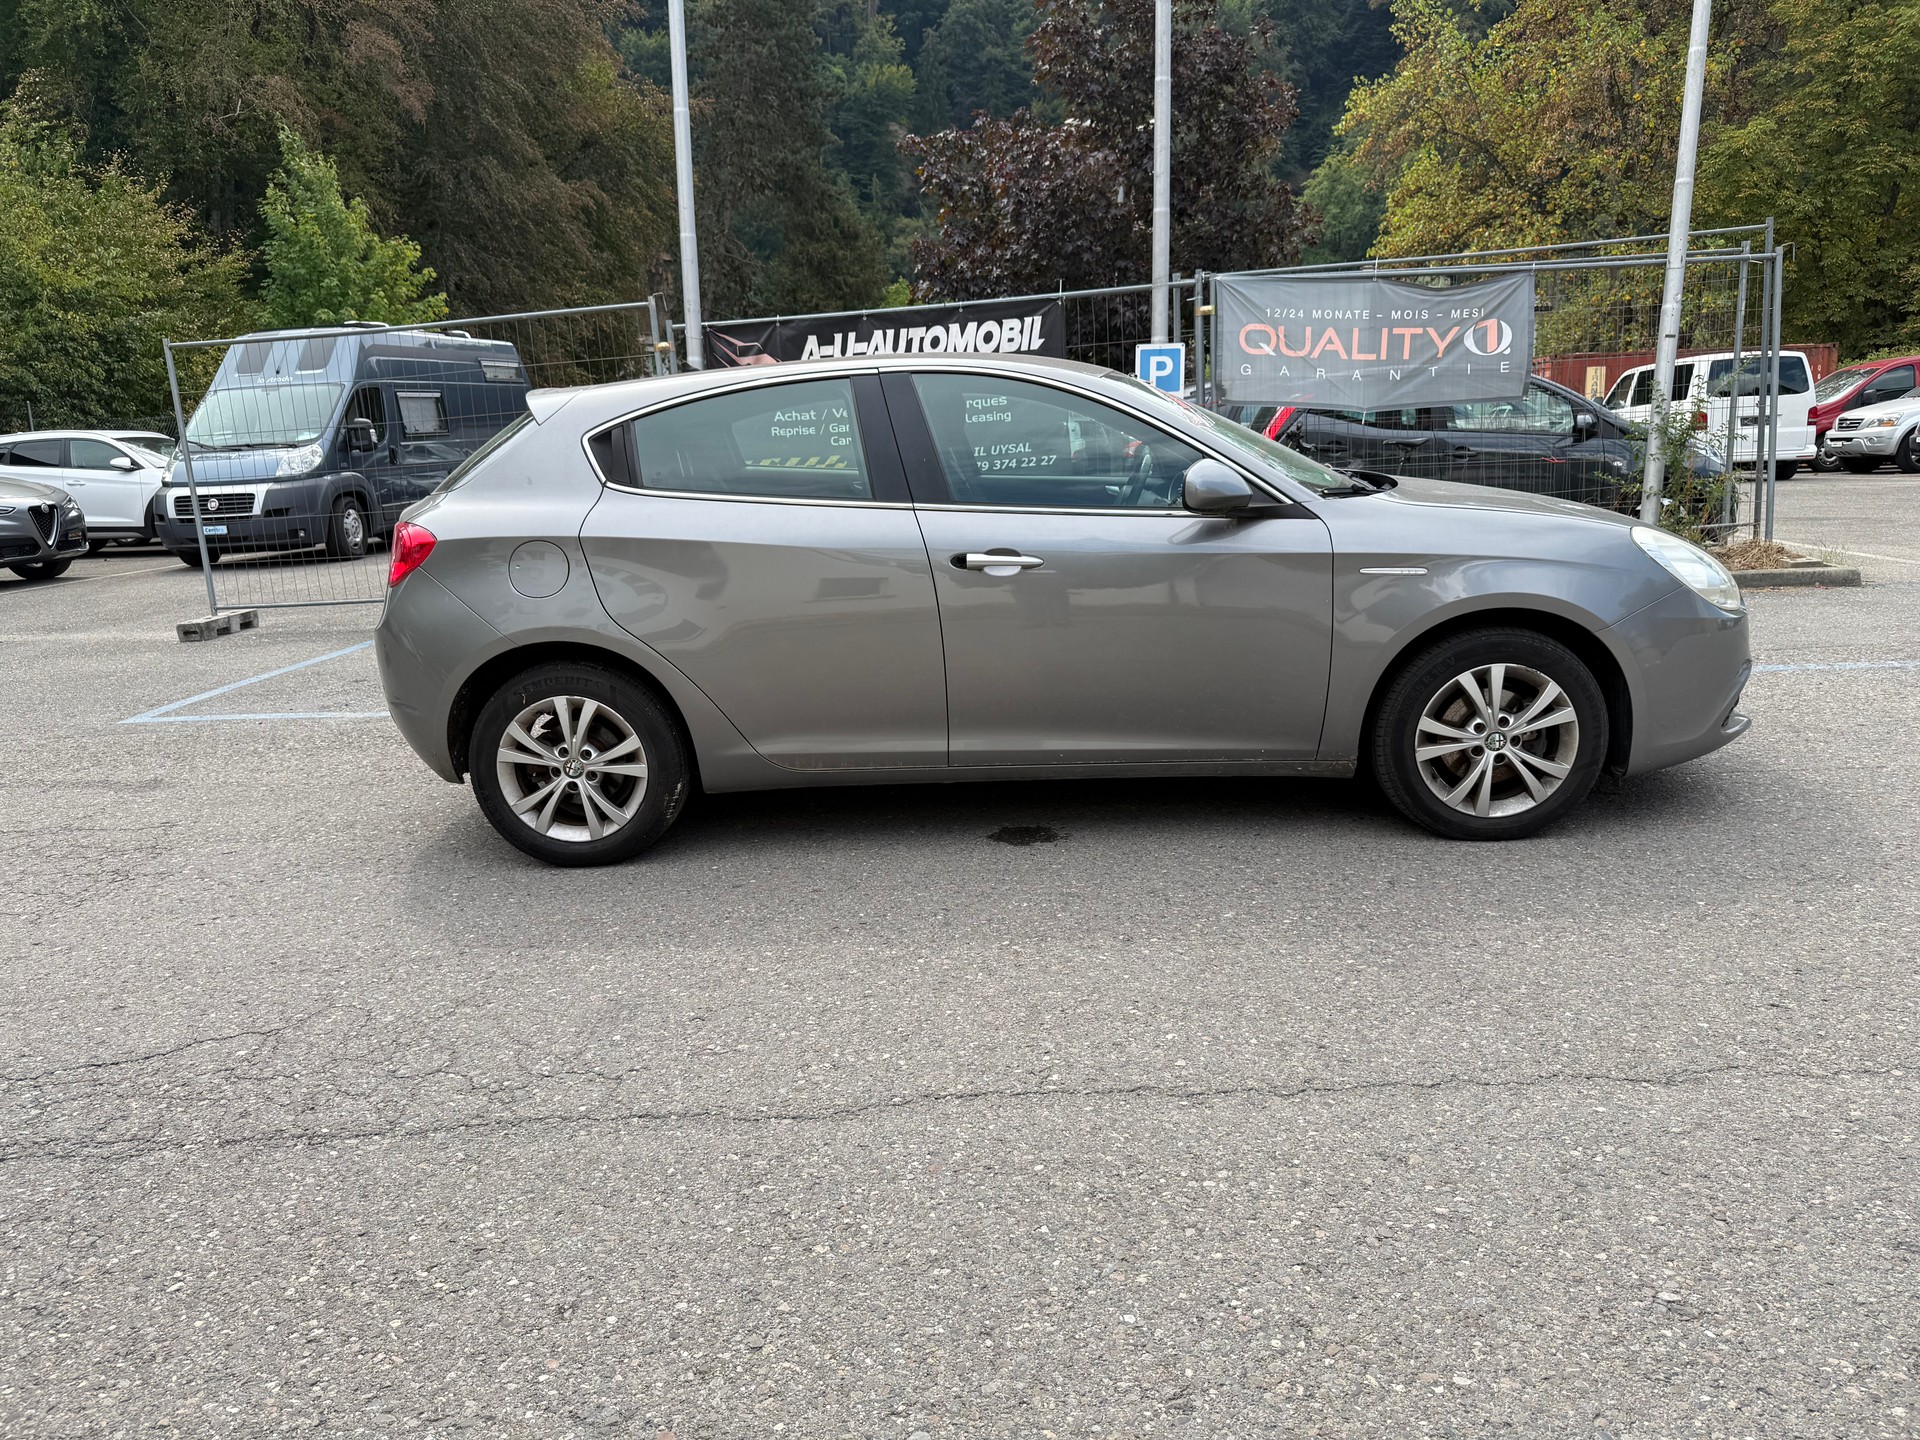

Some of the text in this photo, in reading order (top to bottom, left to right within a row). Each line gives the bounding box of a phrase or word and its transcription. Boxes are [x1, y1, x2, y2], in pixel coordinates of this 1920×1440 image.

[1265, 308, 1305, 319] 12/24
[1312, 309, 1370, 320] MONATE
[1391, 309, 1430, 320] MOIS
[1451, 308, 1485, 319] MESI
[1238, 323, 1461, 360] QUALITY
[1149, 355, 1174, 388] P
[1240, 361, 1510, 381] GARANTIE
[774, 409, 817, 422] Achat
[966, 396, 1008, 410] rques
[771, 425, 816, 438] Reprise
[965, 411, 1012, 424] Leasing
[974, 442, 1032, 457] IL UYSAL
[993, 459, 1017, 470] 374
[1021, 457, 1037, 467] 22
[1041, 455, 1057, 466] 27
